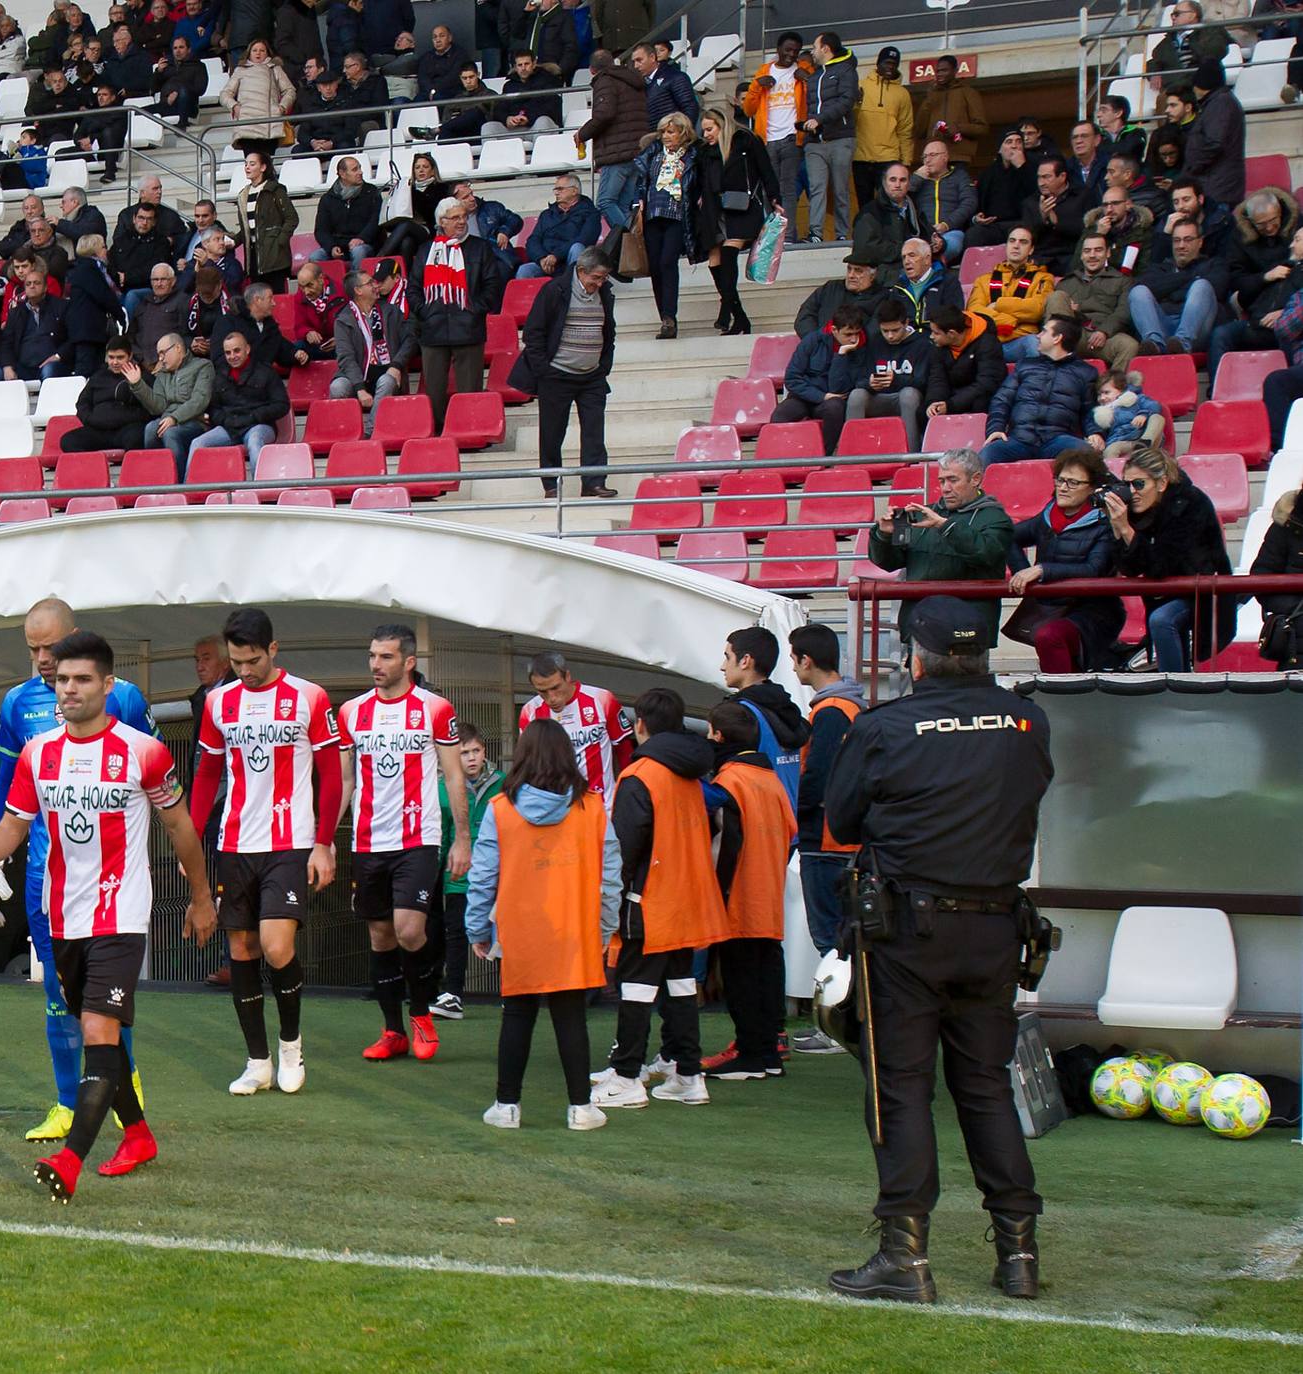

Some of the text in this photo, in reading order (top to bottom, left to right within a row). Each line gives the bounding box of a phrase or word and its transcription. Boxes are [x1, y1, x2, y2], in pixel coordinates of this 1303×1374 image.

[915, 61, 970, 77] SAA
[875, 359, 913, 374] FILA
[953, 630, 976, 638] CNP
[259, 724, 300, 744] HOUSE
[915, 714, 1018, 736] POLICIA
[355, 734, 429, 752] ATUR HOUSE
[41, 785, 132, 810] ATUR HOUSE
